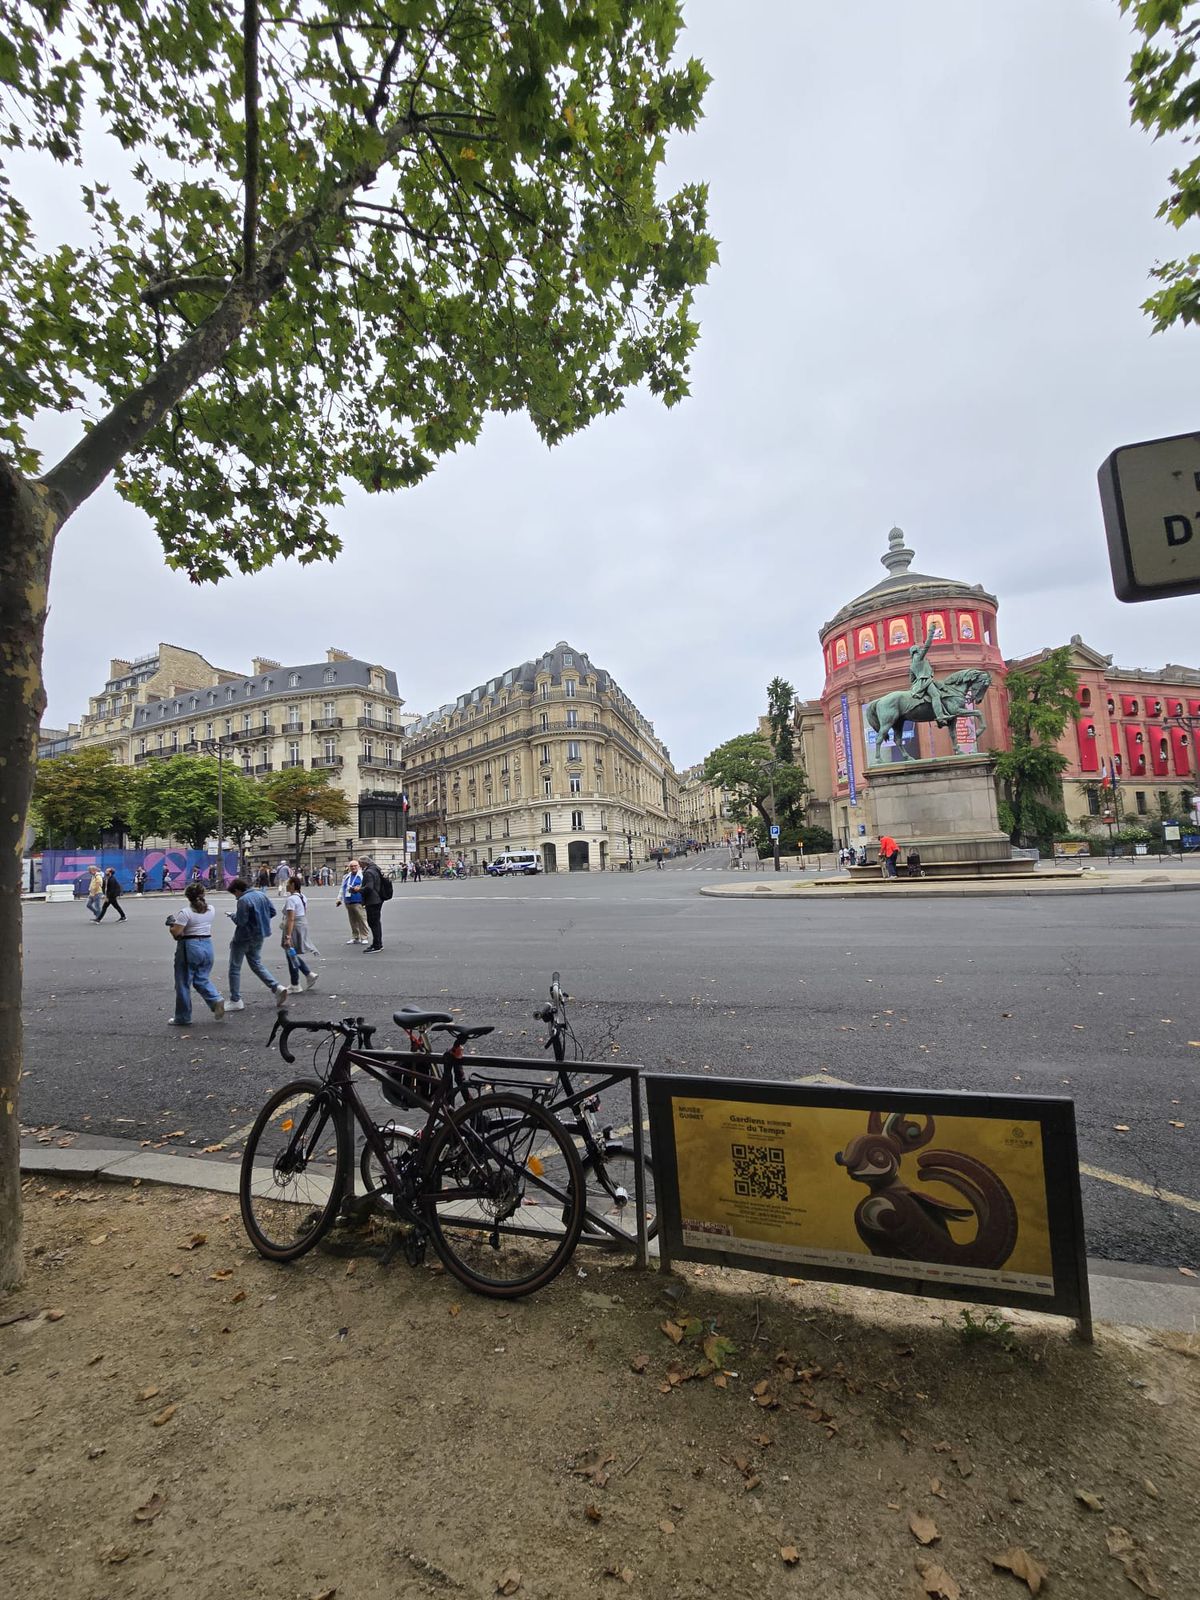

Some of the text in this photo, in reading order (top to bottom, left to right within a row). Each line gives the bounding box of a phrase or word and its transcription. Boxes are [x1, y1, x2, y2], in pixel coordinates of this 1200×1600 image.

[1163, 511, 1200, 547] D
[729, 1115, 765, 1125] Gardiens
[757, 1125, 786, 1136] Temps
